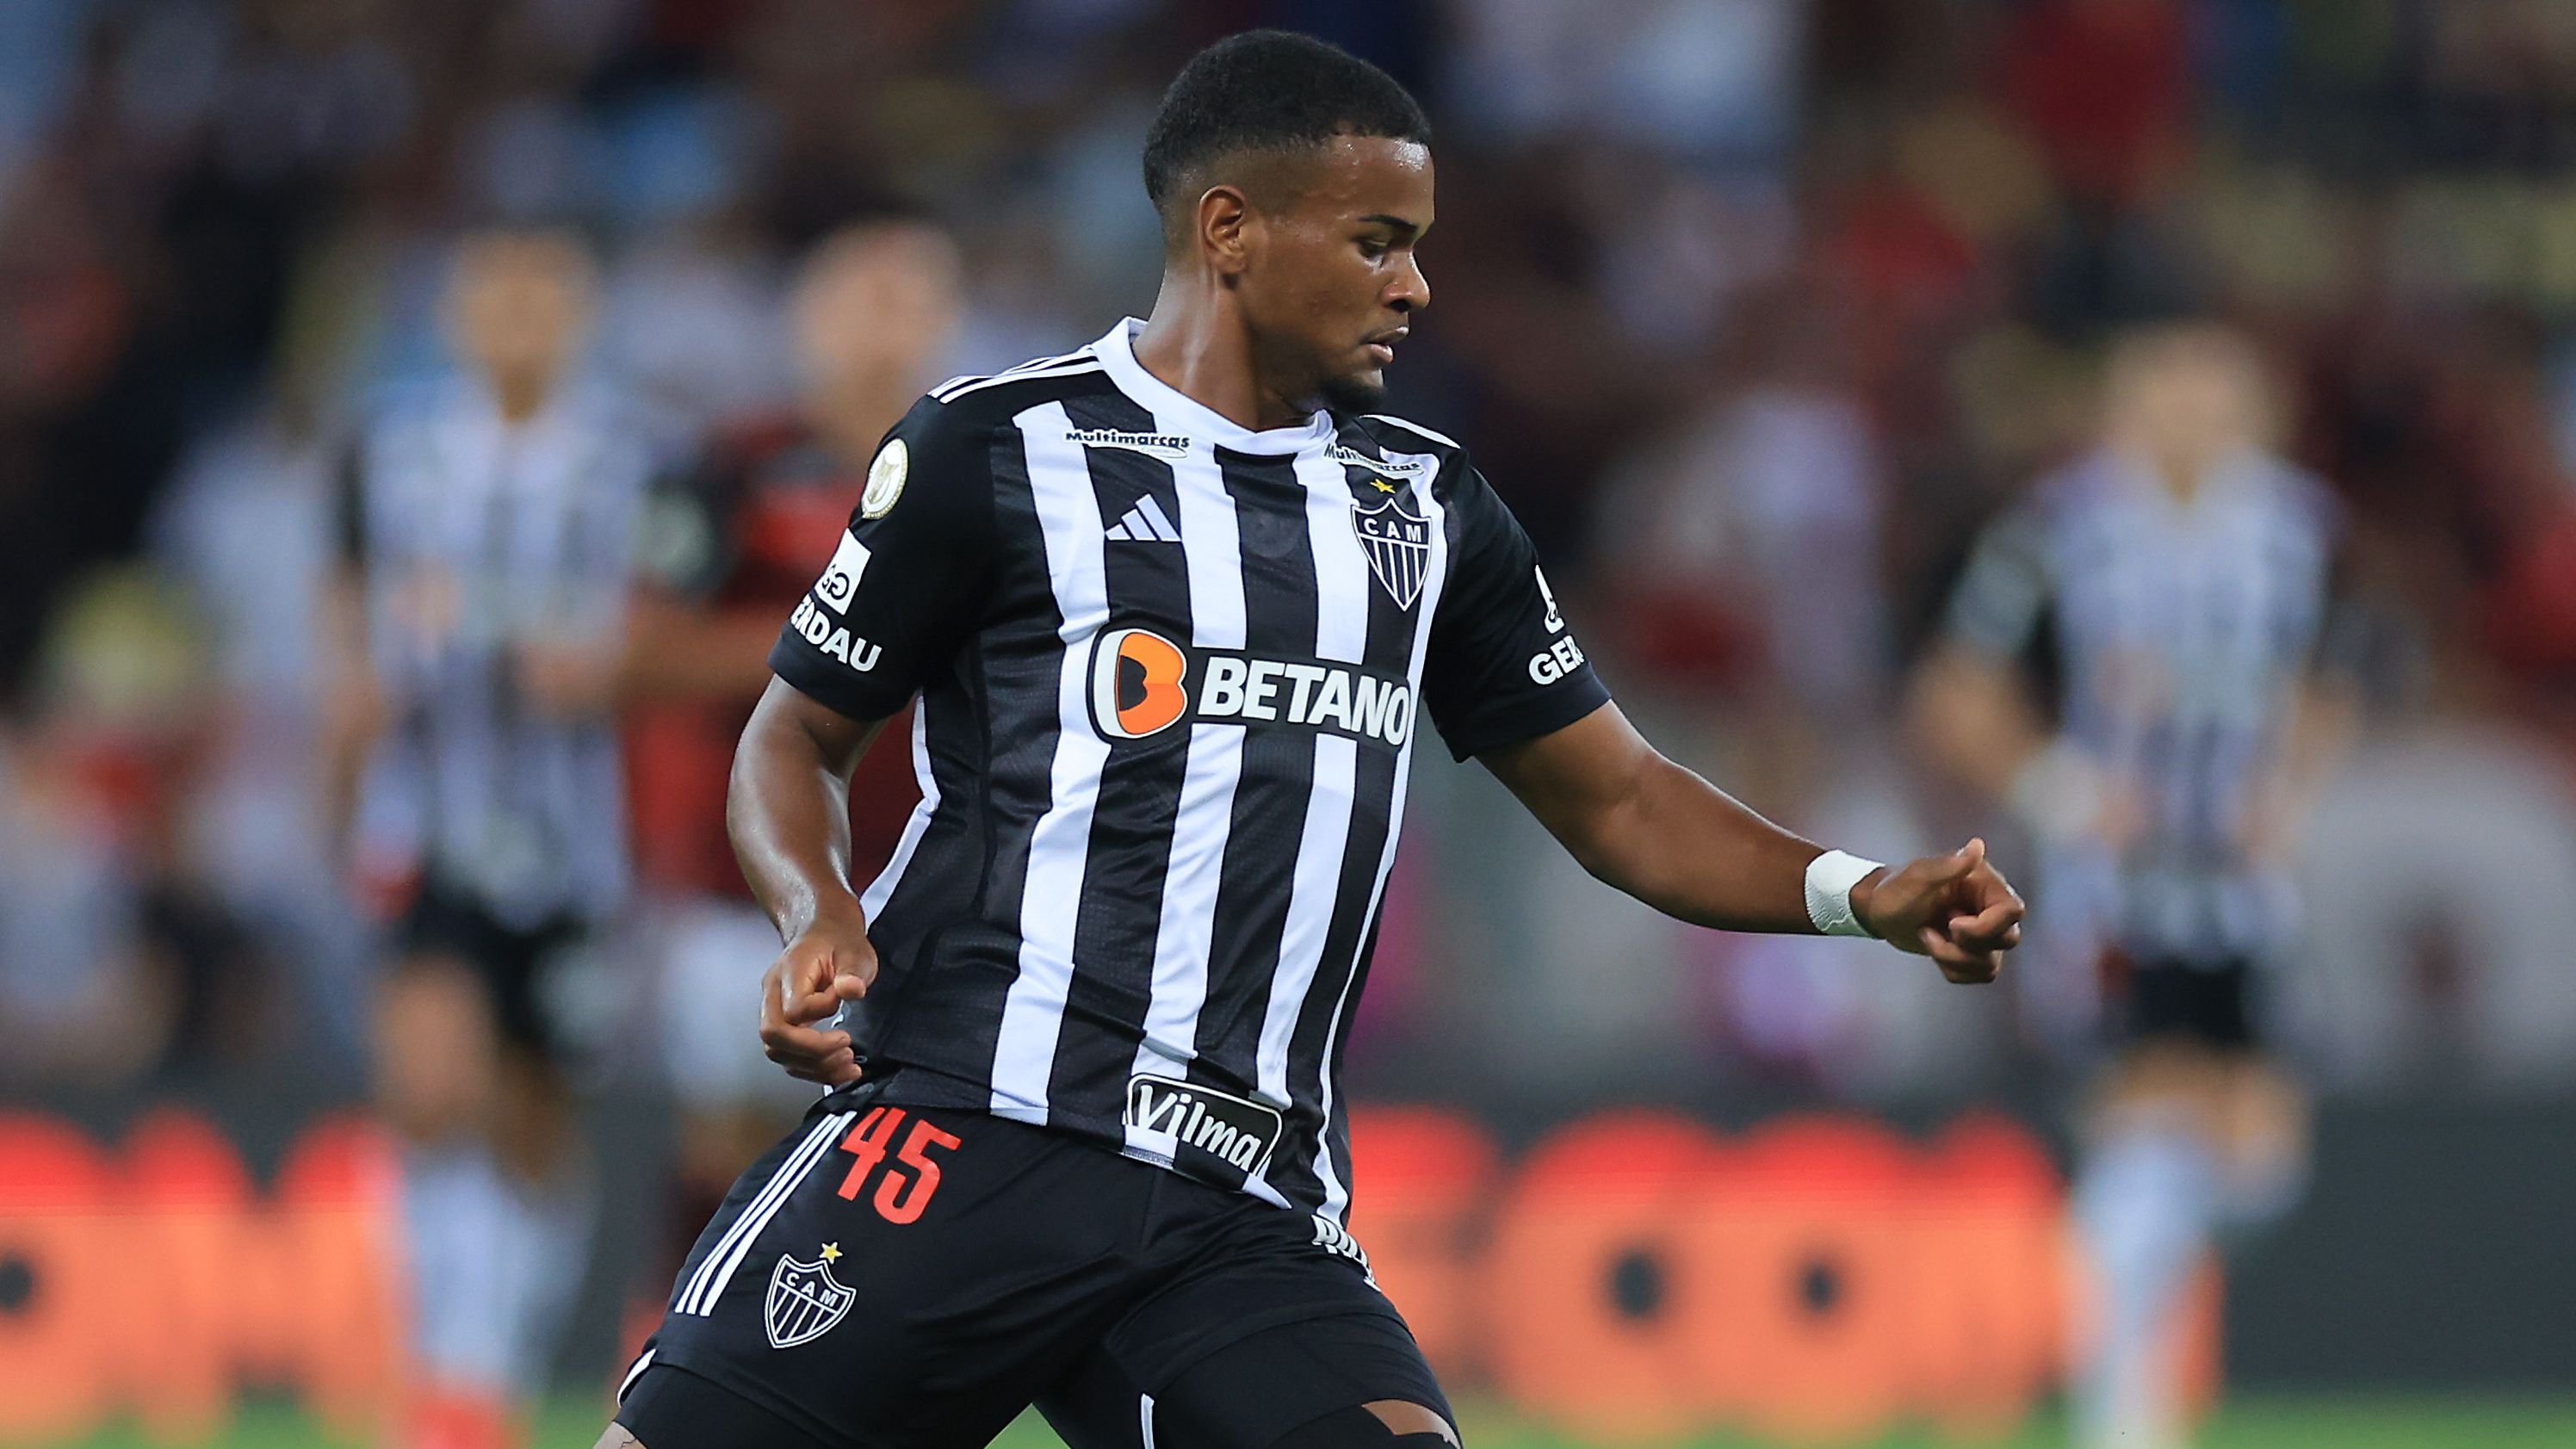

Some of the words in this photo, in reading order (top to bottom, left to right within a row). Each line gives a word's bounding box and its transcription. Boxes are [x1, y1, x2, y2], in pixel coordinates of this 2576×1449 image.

[1065, 431, 1190, 449] Multimarcas
[1365, 518, 1421, 542] CAM
[790, 593, 882, 672] ERDAU
[1198, 656, 1409, 746] BETANO
[838, 1107, 962, 1224] 45
[1137, 1084, 1261, 1172] Vilma
[787, 1273, 839, 1307] CAM
